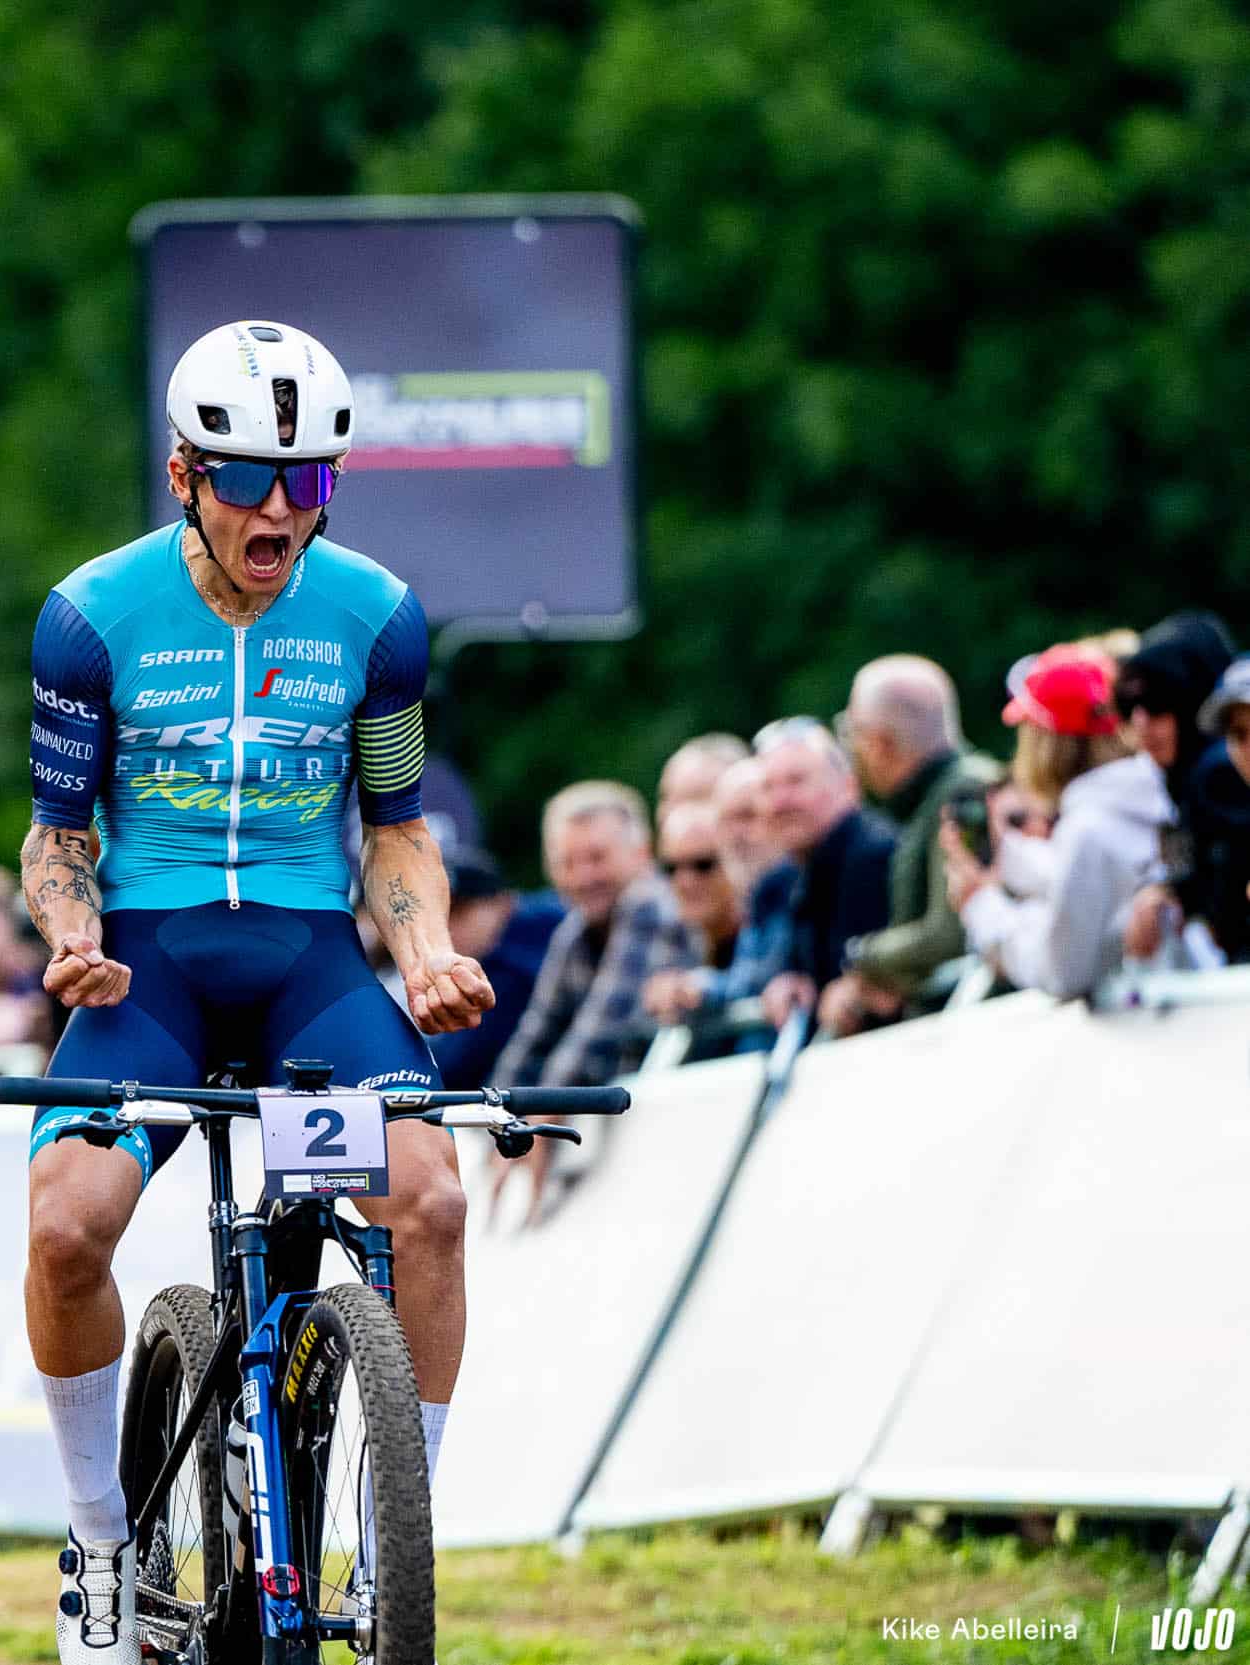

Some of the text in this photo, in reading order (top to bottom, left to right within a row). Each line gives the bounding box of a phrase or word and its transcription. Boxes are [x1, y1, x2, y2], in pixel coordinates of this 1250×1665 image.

[139, 649, 224, 668] SRAM
[263, 638, 342, 666] ROCKSHOX
[131, 682, 222, 710] Santini
[253, 668, 346, 705] Segafredo
[118, 716, 352, 747] TREK
[33, 762, 87, 791] SWISS
[129, 771, 340, 823] Racing
[303, 1108, 348, 1158] 2
[286, 1321, 319, 1405] MAXXIS
